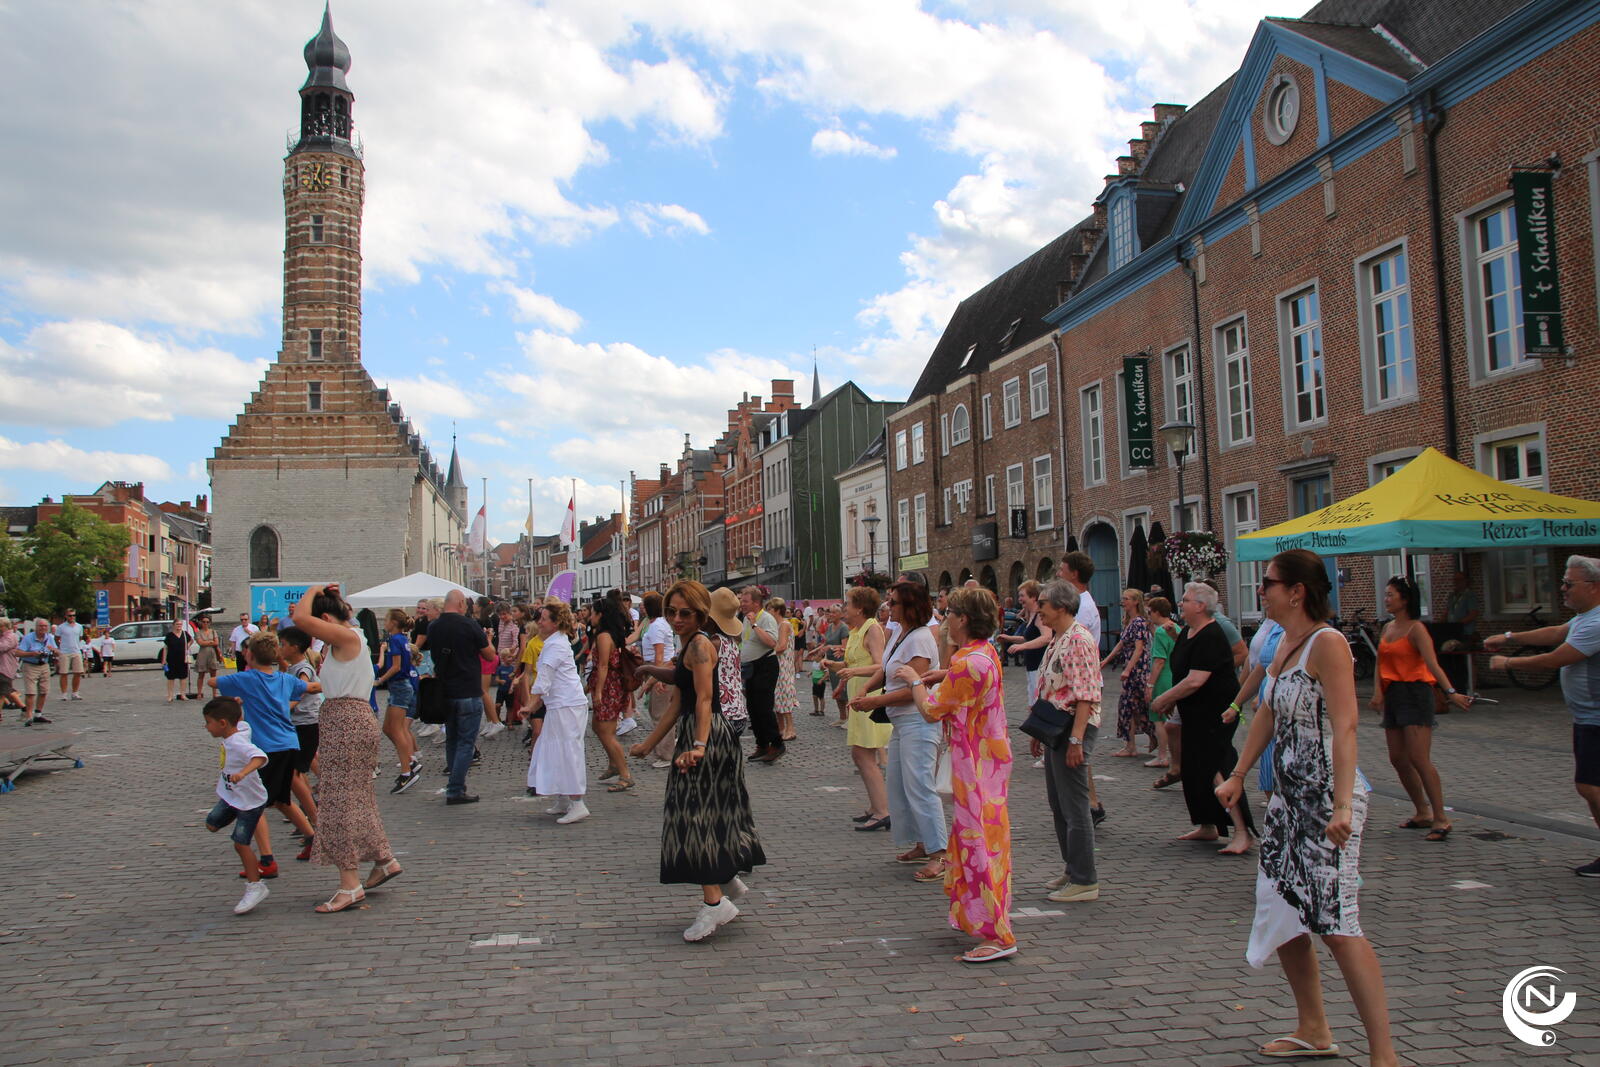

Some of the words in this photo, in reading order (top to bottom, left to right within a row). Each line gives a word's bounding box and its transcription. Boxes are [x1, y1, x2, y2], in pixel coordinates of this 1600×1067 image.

[1132, 447, 1152, 459] CC
[1434, 492, 1513, 505] Keizer
[1479, 502, 1577, 514] Hertals
[1482, 521, 1529, 543] Keizer
[1543, 520, 1597, 537] Hertals
[1275, 537, 1304, 553] Keizer
[1311, 530, 1347, 548] Hertals
[98, 591, 106, 601] P
